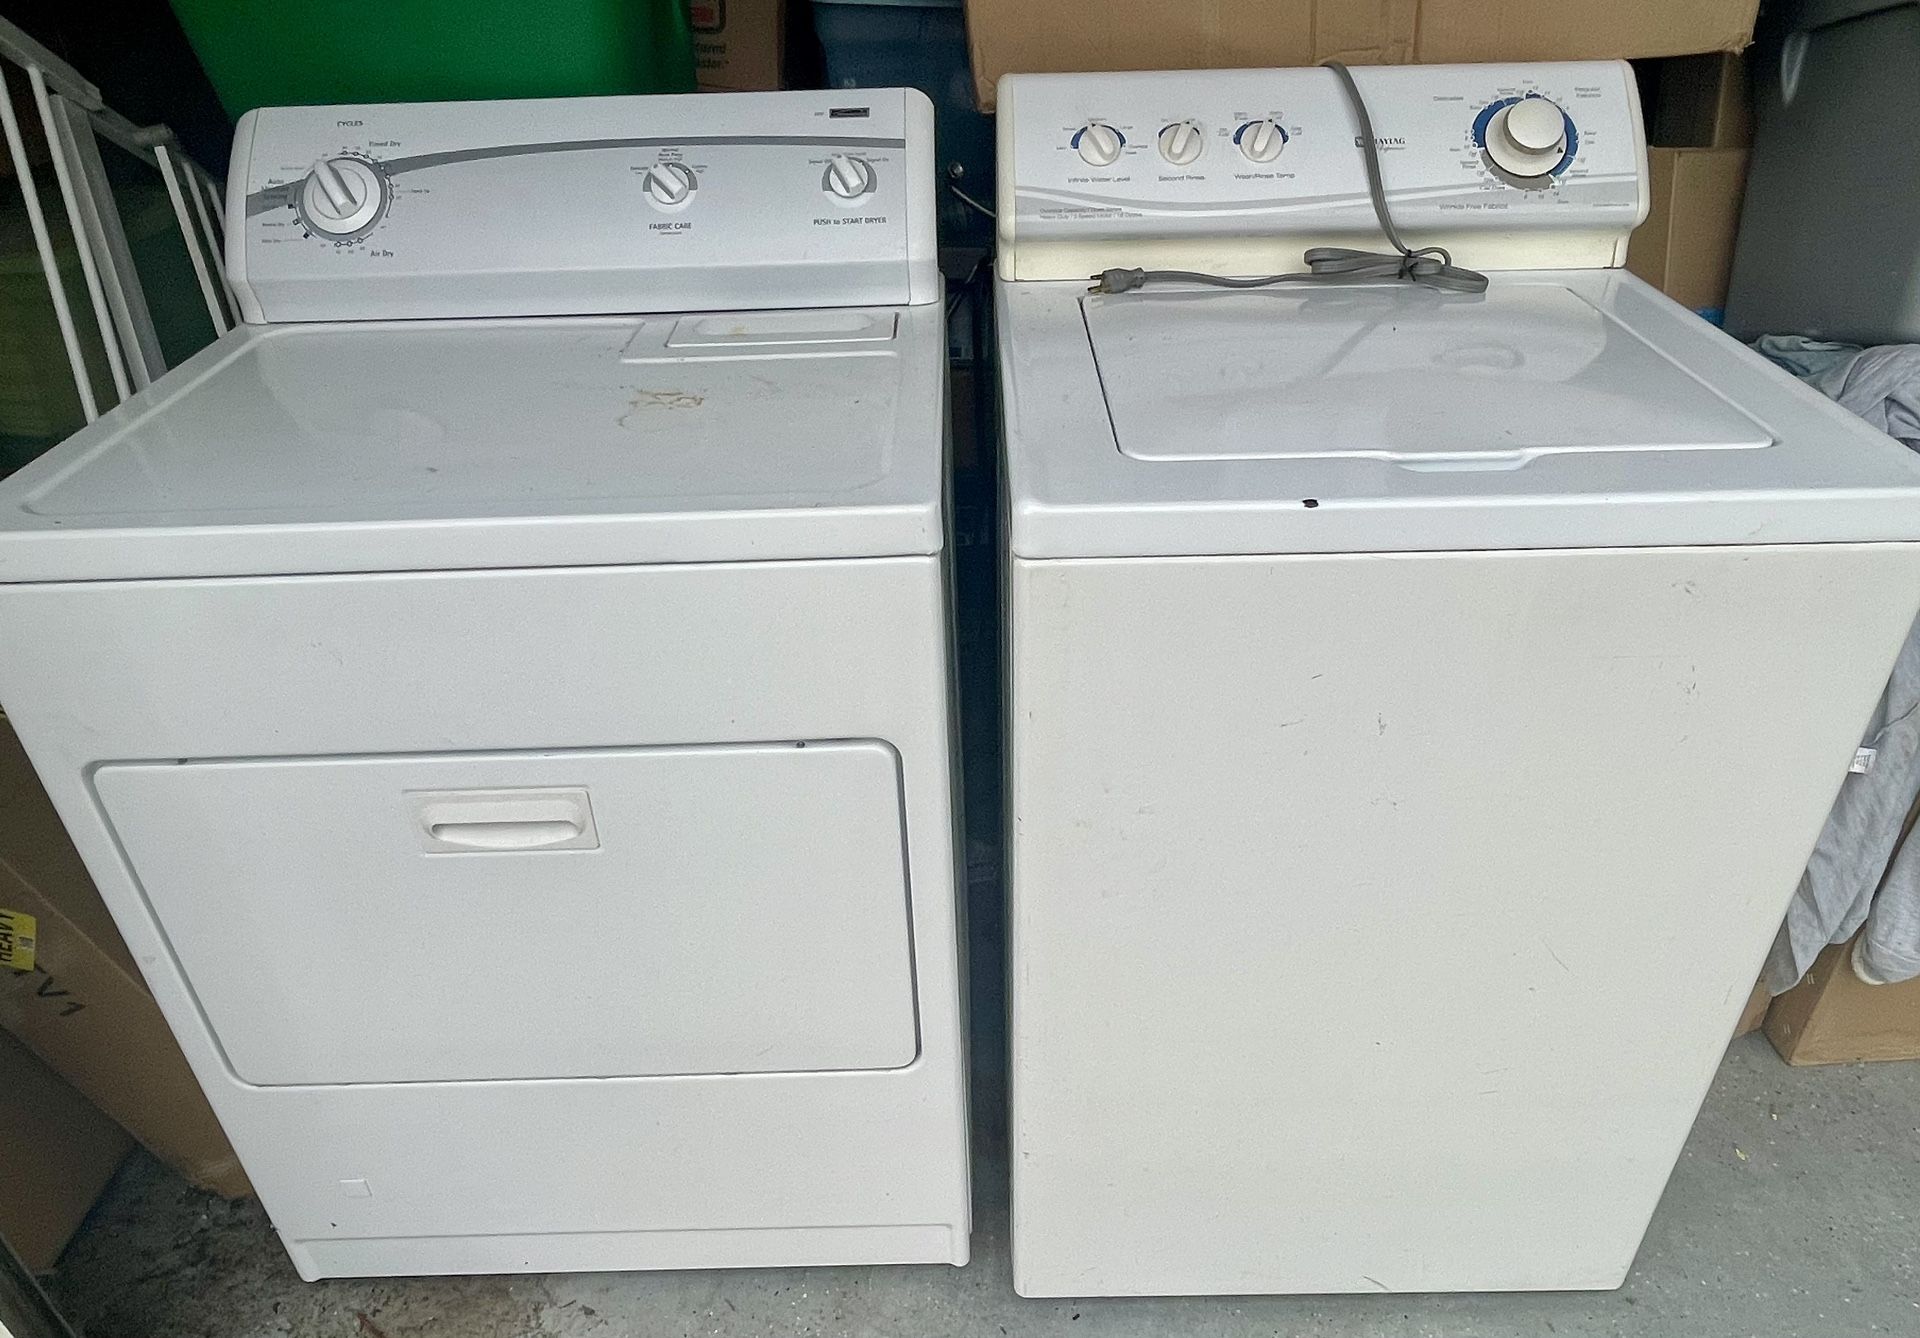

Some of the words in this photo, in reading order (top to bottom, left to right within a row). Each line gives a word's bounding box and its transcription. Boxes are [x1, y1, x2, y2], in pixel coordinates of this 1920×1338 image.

[336, 120, 364, 128] CYCLES
[389, 140, 402, 148] Dry
[812, 218, 831, 226] PUSH
[842, 217, 864, 225] START
[864, 216, 887, 224] DRYER
[648, 222, 673, 230] FABRIC
[674, 222, 692, 230] CARE
[370, 249, 381, 258] Air
[382, 249, 395, 259] Dry
